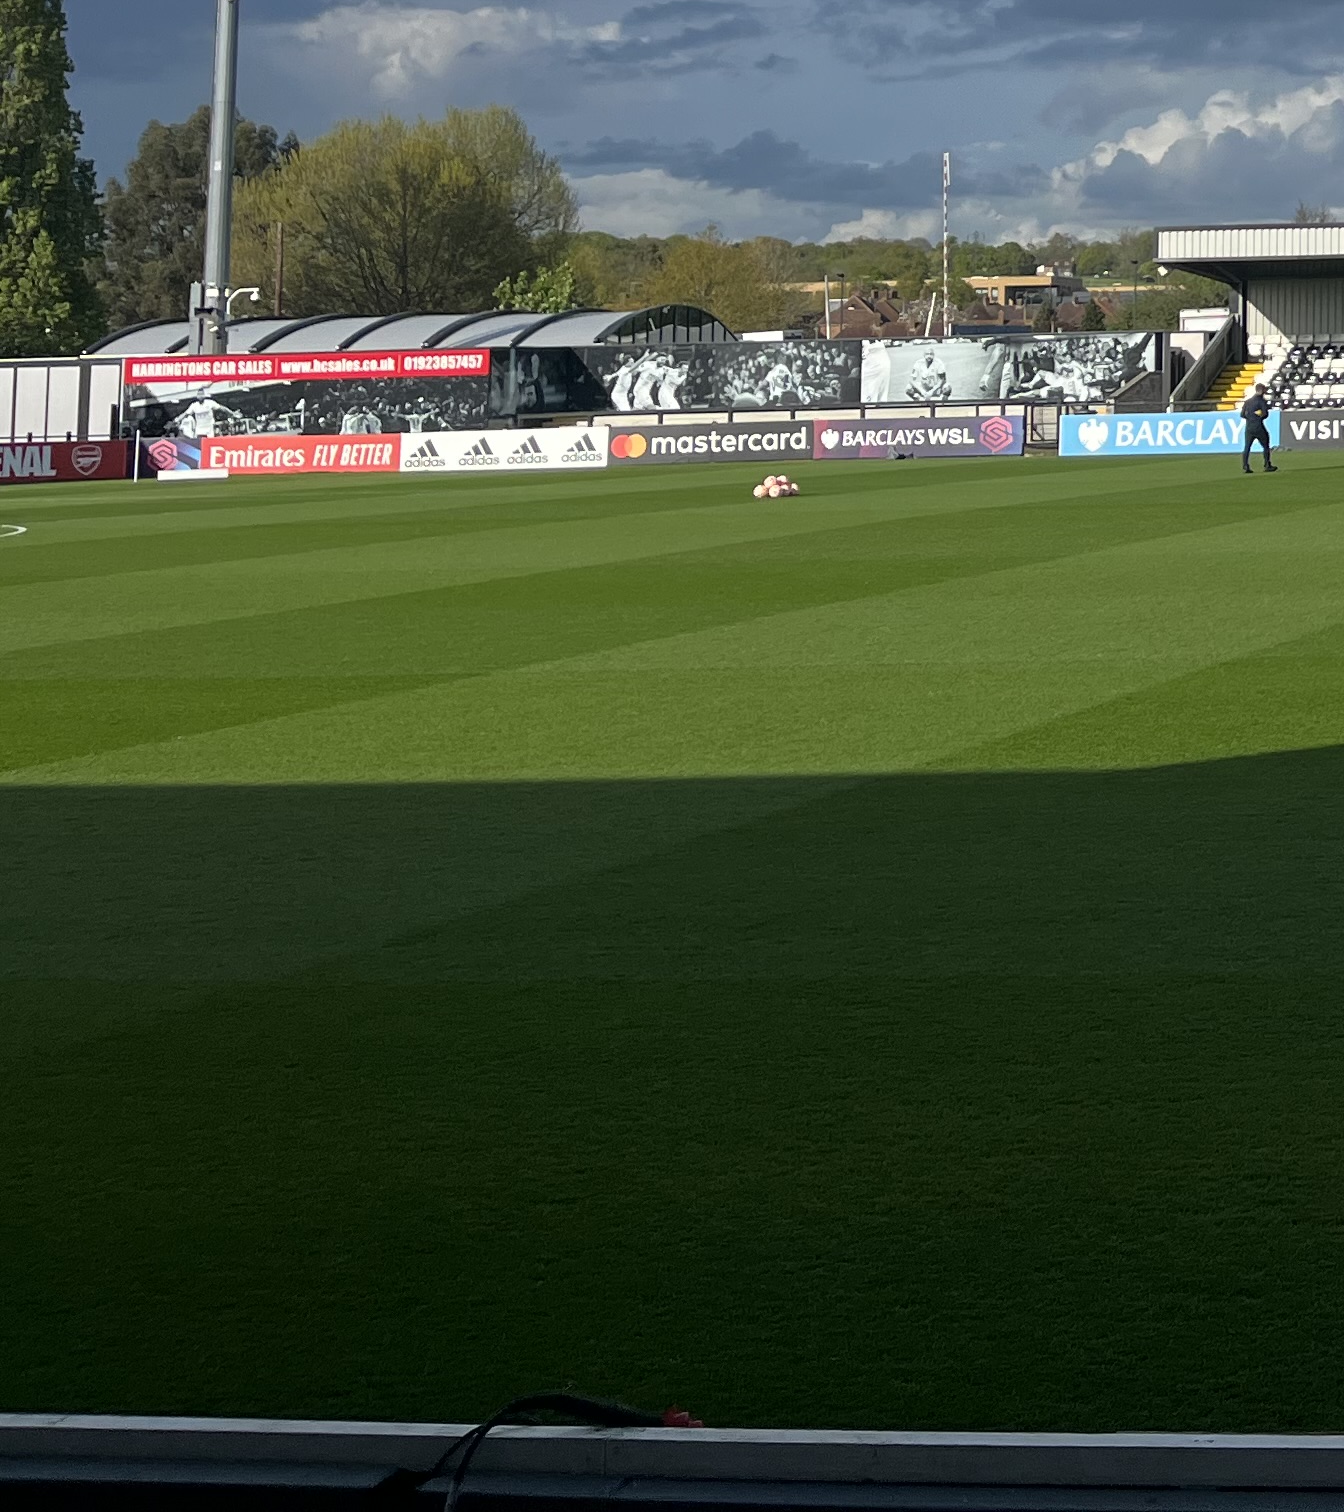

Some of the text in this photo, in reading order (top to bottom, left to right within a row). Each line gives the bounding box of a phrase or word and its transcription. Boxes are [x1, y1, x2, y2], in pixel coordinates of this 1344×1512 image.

[132, 361, 211, 378] HARRINGTONS
[213, 360, 236, 376] CAR
[238, 359, 273, 375] SALES
[281, 356, 396, 374] www.hcsales.co.uk
[651, 426, 807, 455] mastercard
[842, 427, 975, 447] BARCLAYS WSL
[1115, 419, 1246, 447] BARCLAY
[0, 445, 57, 478] NAL
[210, 443, 393, 468] Emirates FLY BETTER
[404, 450, 603, 469] adidas adidas adidas adidas
